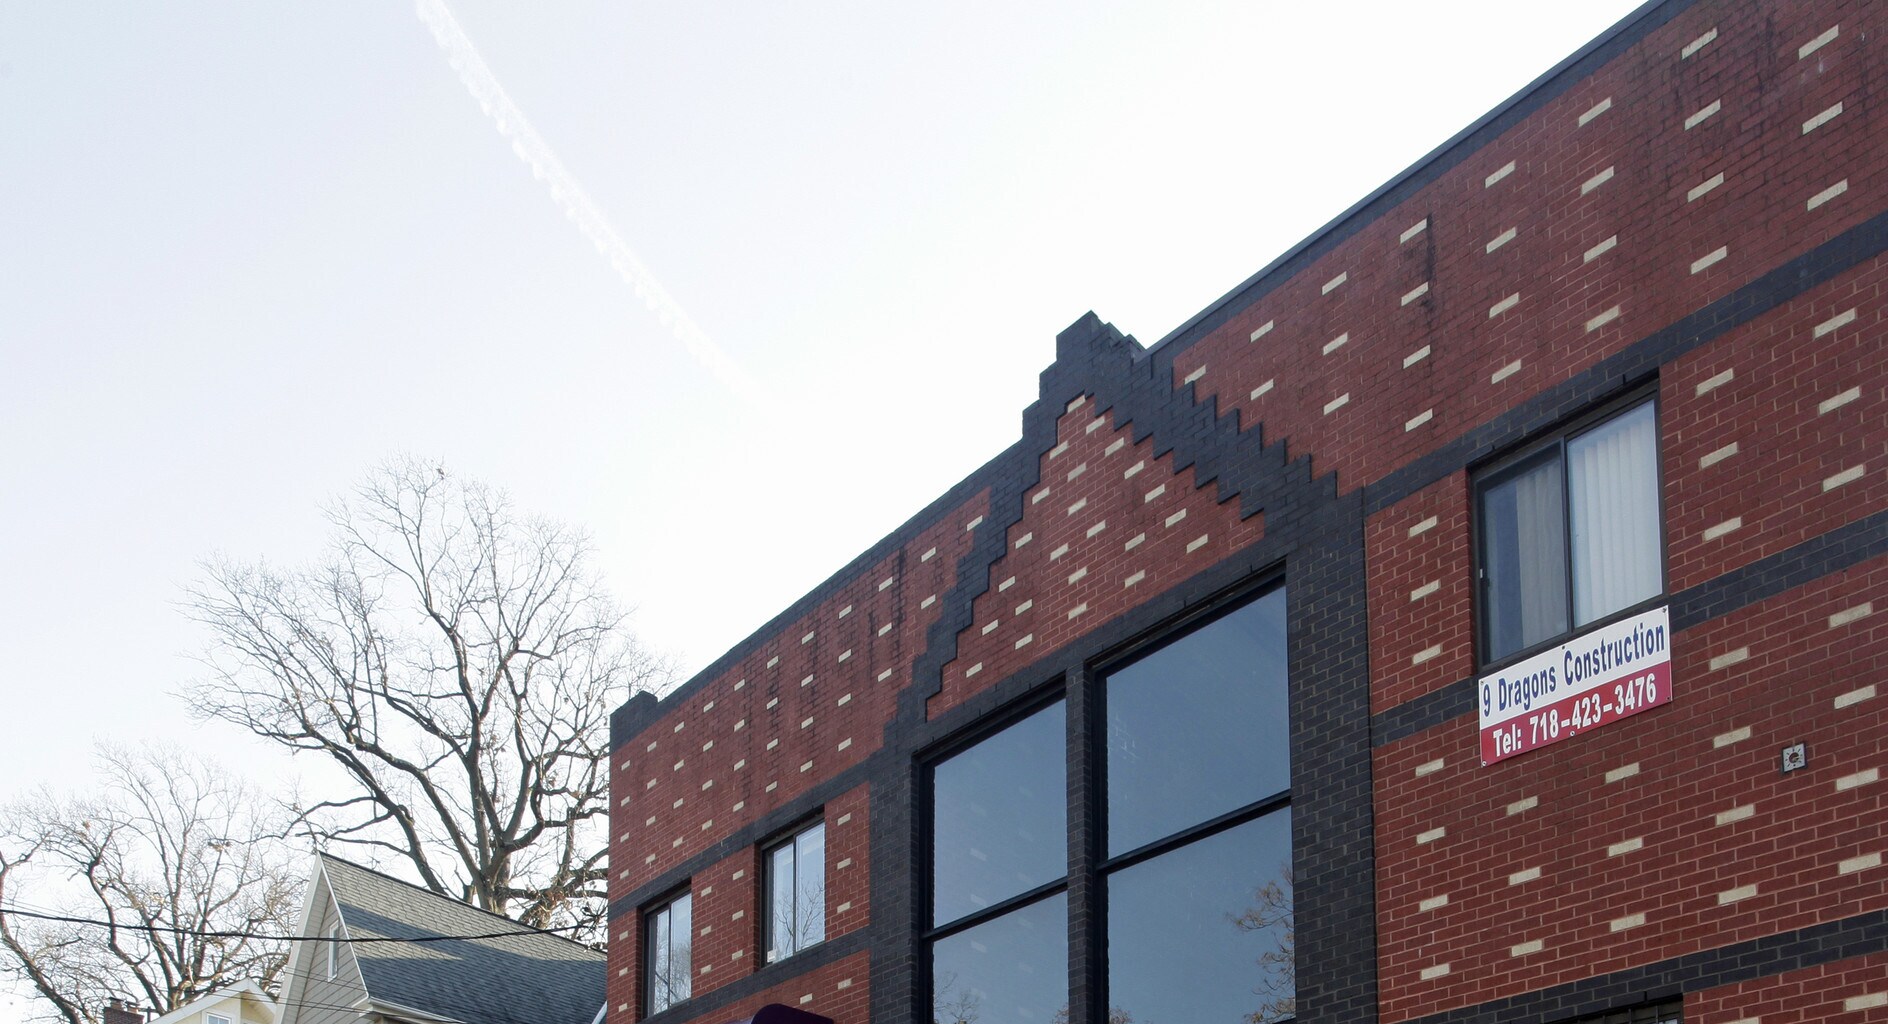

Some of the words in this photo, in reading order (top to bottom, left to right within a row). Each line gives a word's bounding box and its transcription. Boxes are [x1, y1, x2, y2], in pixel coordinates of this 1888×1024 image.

[1483, 684, 1491, 717] 9
[1498, 665, 1556, 711] Dragons
[1564, 622, 1665, 685] Construction
[1493, 723, 1522, 757] Tel:
[1529, 672, 1657, 745] 718-423-3476
